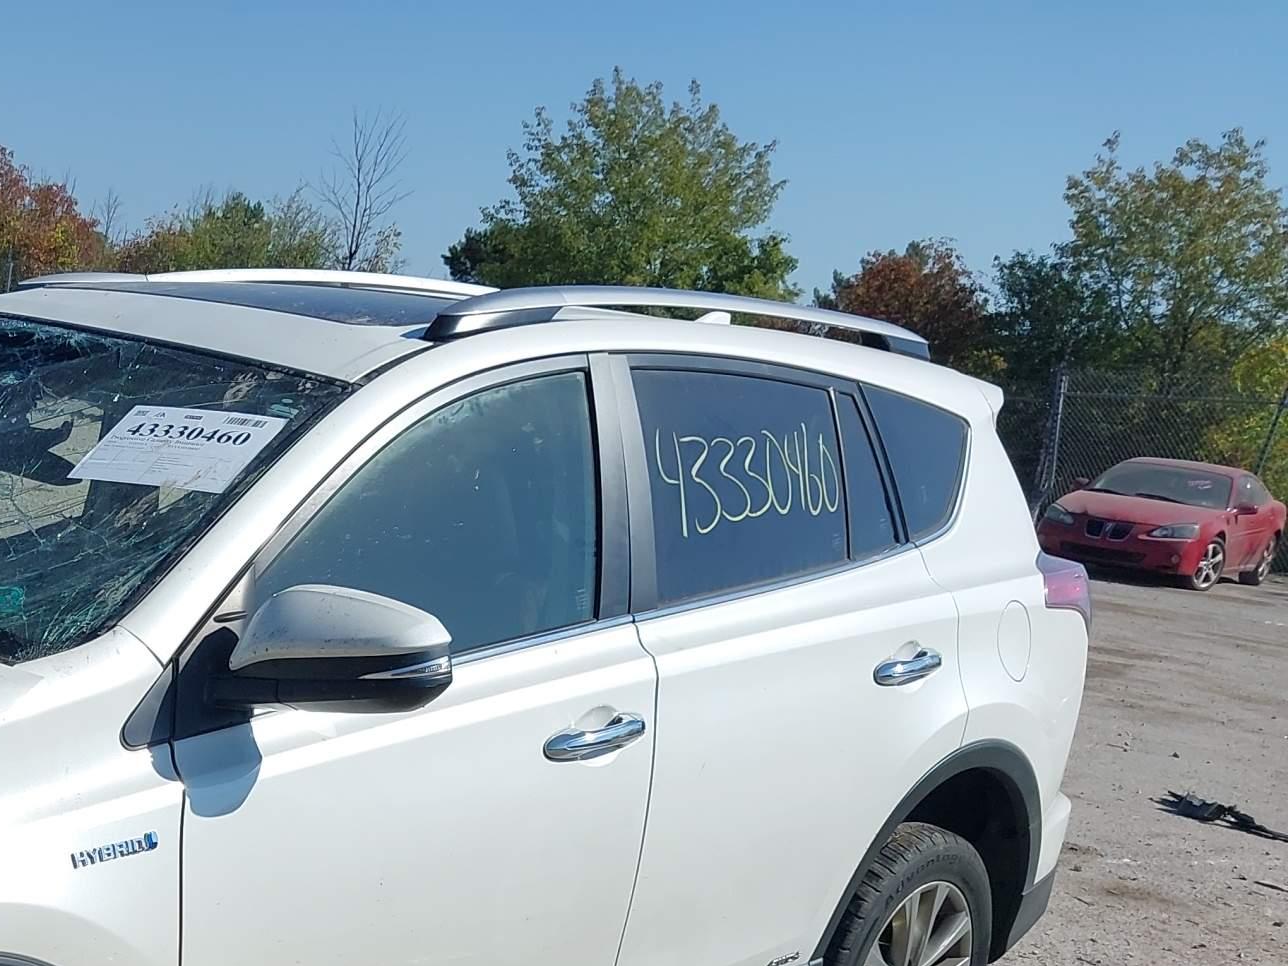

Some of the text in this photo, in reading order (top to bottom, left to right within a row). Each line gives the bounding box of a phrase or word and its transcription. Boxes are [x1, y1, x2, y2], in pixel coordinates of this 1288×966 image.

[126, 421, 252, 447] 43330460
[655, 422, 839, 538] 43330460
[71, 838, 149, 869] HYBRID
